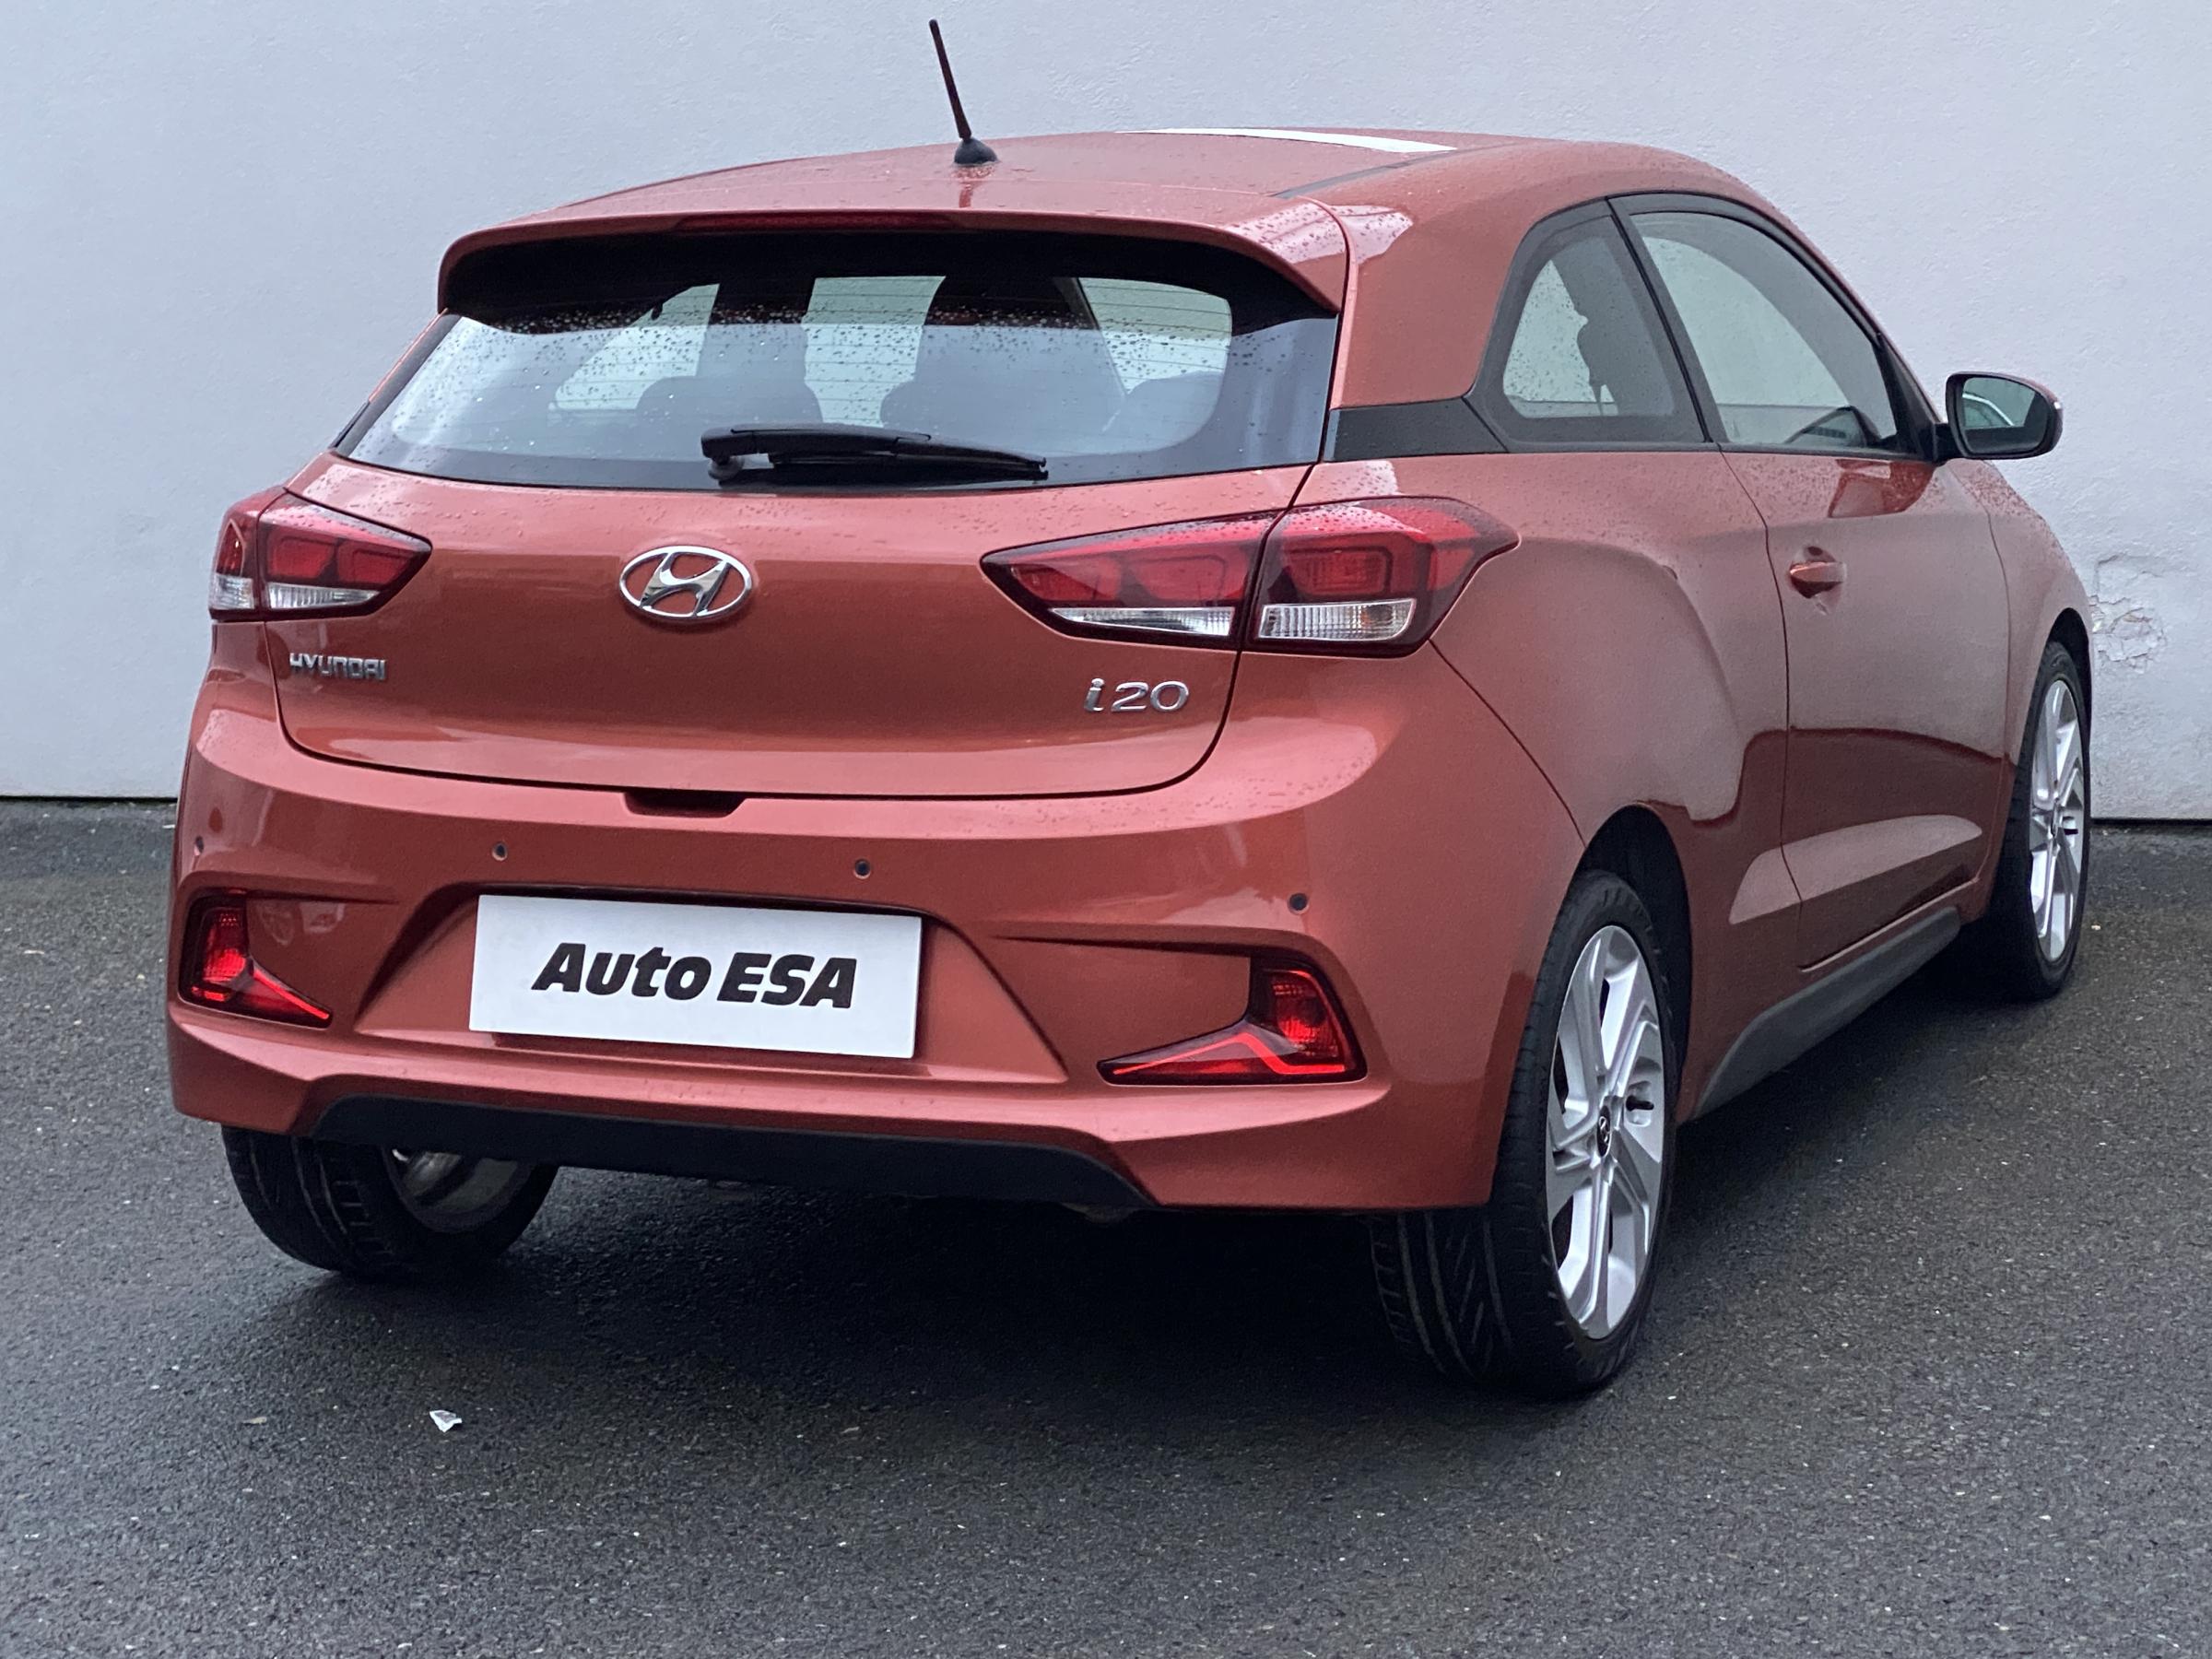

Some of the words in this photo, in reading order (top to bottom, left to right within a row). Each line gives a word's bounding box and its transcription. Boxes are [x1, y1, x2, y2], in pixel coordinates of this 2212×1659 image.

[288, 653, 387, 680] HYUNDAI
[1084, 677, 1190, 712] i20
[531, 942, 712, 1001] Auto
[716, 952, 858, 1009] ESA
